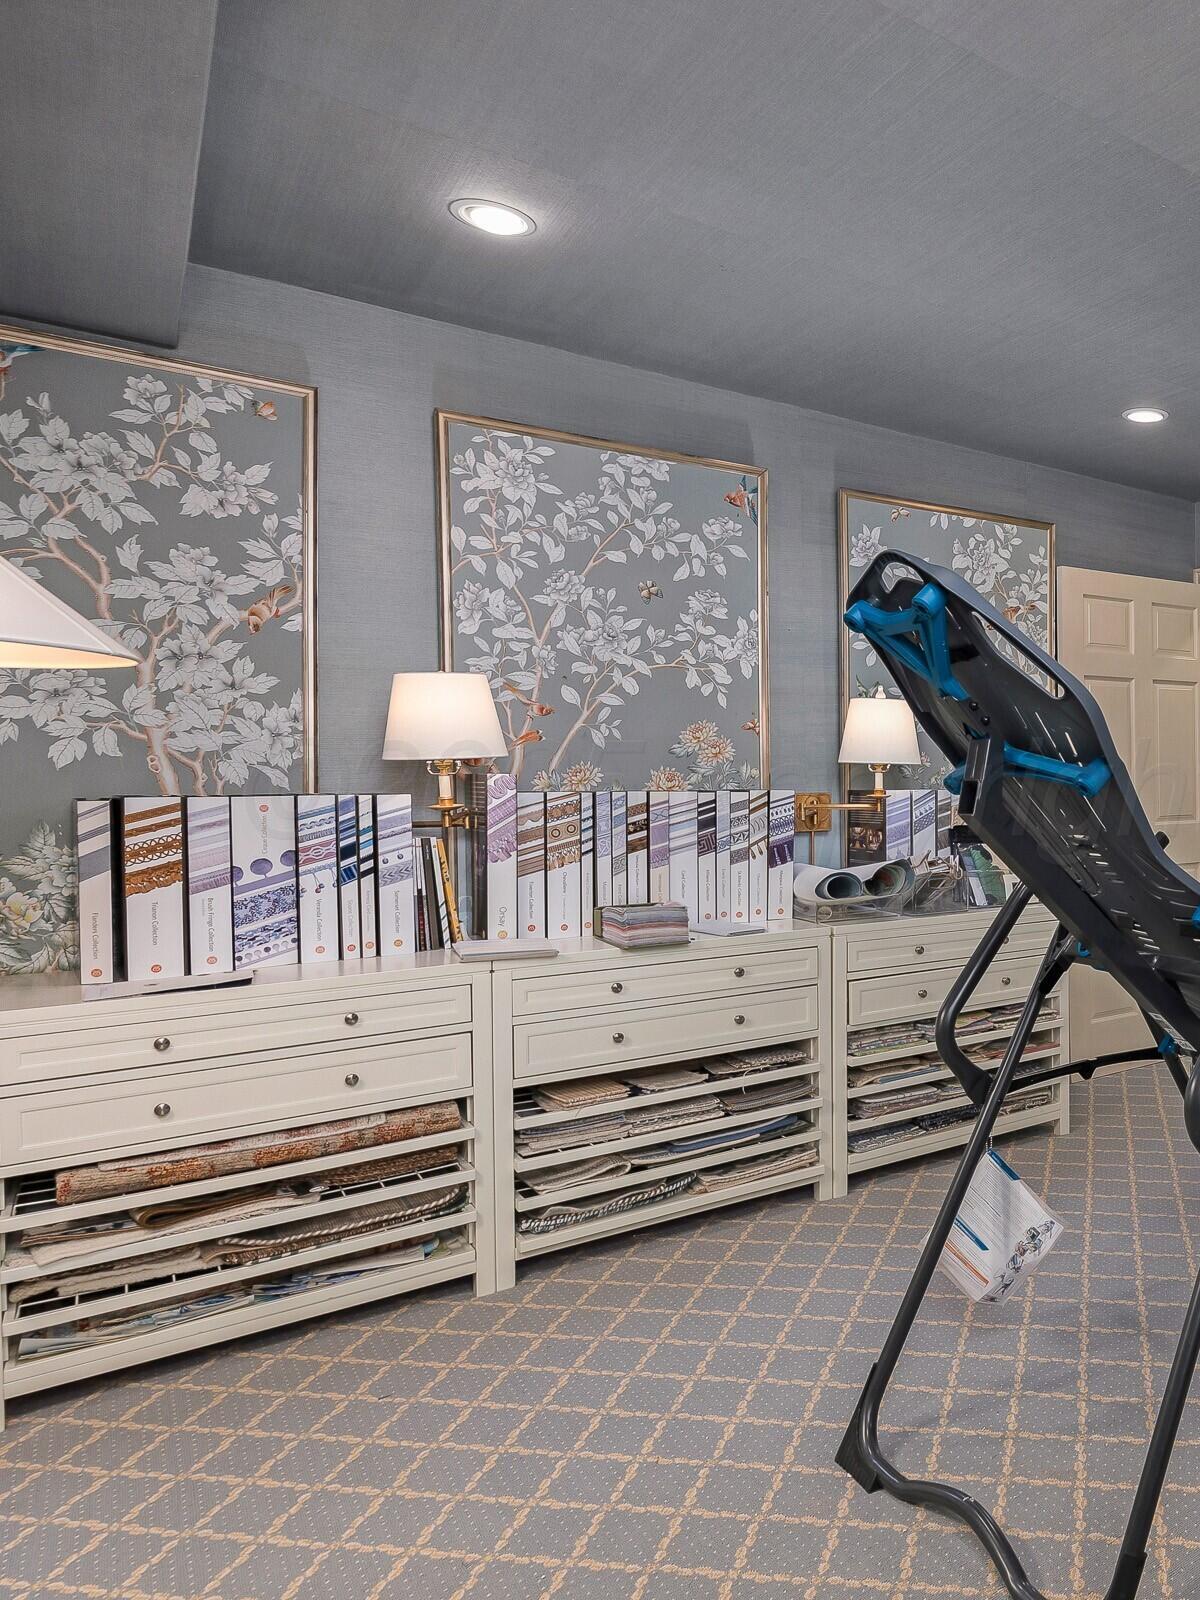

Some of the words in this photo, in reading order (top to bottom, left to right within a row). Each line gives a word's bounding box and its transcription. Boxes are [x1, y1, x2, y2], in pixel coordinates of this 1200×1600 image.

[497, 906, 508, 927] Orsay
[151, 921, 160, 946] Collection
[208, 928, 216, 952] Collection
